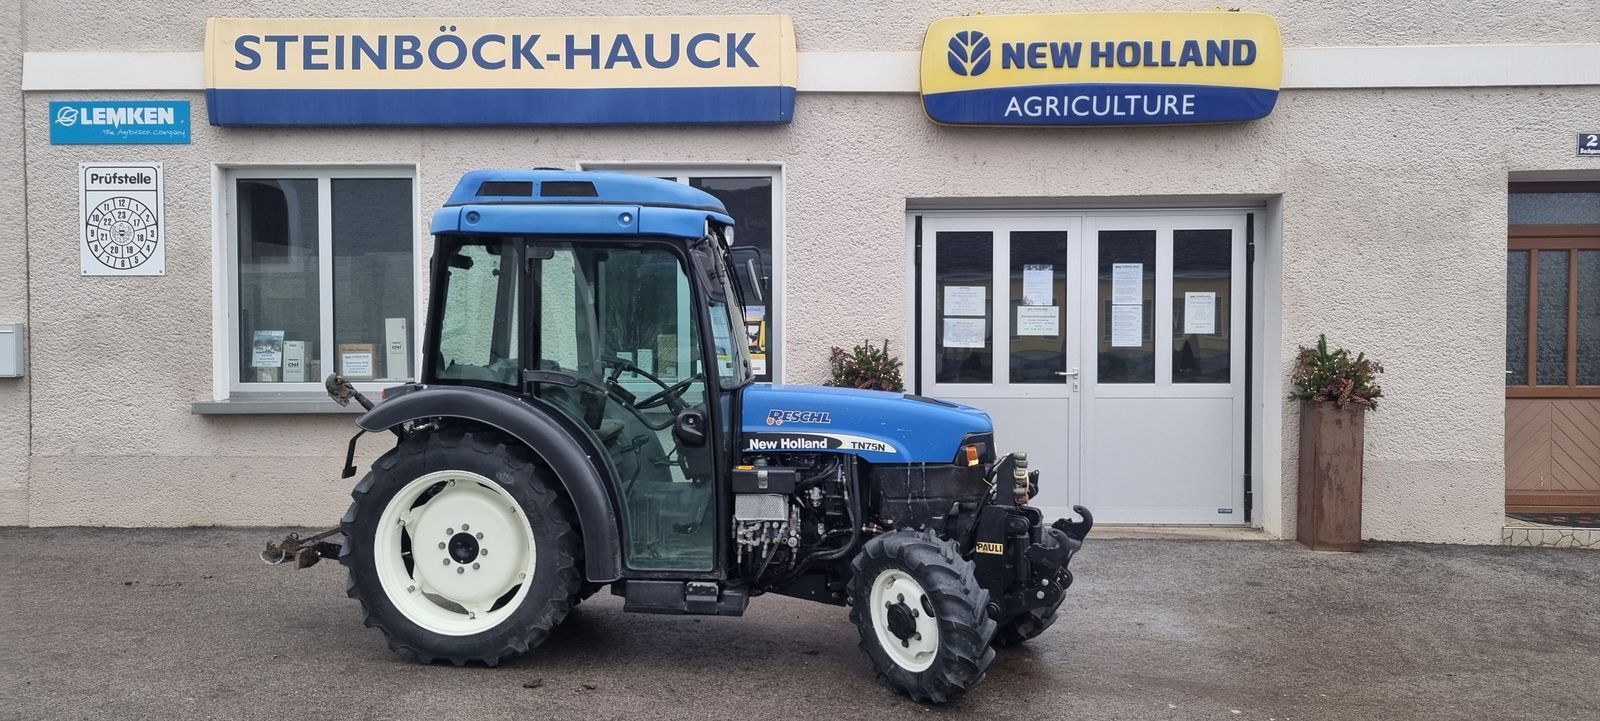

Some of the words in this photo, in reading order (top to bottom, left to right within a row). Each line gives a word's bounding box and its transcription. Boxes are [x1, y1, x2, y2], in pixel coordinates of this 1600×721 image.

[234, 25, 760, 72] STEINBÖCK-HAUCK
[1002, 41, 1082, 69] NEW
[1090, 39, 1257, 68] HOLLAND
[1004, 94, 1196, 117] AGRICULTURE
[80, 107, 174, 128] LEMKEN
[1586, 134, 1598, 146] 2
[90, 172, 152, 185] Prüfstelle
[118, 199, 126, 208] 12
[92, 214, 100, 222] 10
[117, 211, 126, 219] 23
[103, 218, 112, 226] 22
[133, 219, 141, 227] 17
[100, 233, 108, 241] 21
[110, 246, 119, 254] 20
[126, 246, 134, 254] 19
[767, 409, 831, 425] RESCHL
[750, 439, 777, 450] New
[781, 438, 828, 450] Holland
[851, 441, 886, 452] TN75N
[977, 543, 1002, 553] PAULI
